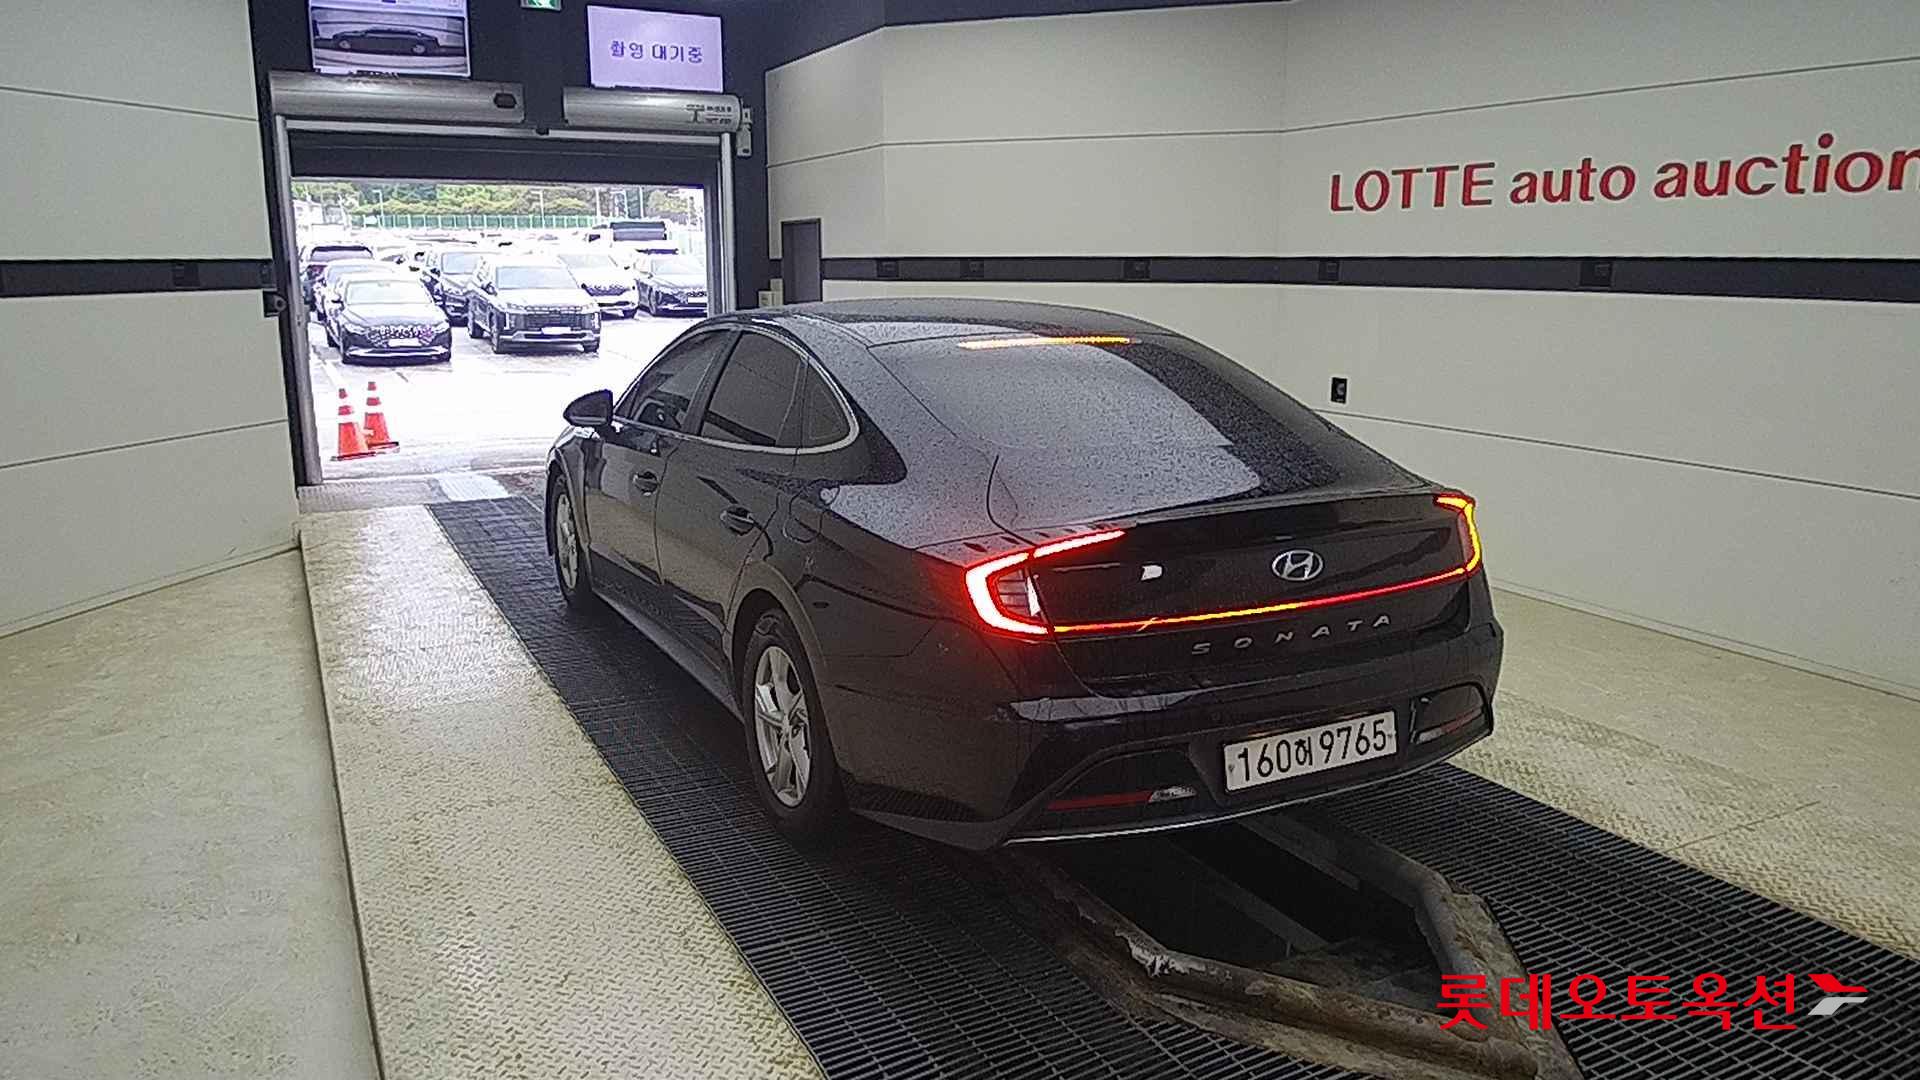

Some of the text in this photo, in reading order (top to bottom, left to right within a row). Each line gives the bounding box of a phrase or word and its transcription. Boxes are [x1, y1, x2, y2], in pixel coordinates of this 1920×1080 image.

[652, 43, 702, 64] 대기중
[1330, 132, 1920, 213] LOTTE auto auction
[1191, 614, 1390, 655] SONATA
